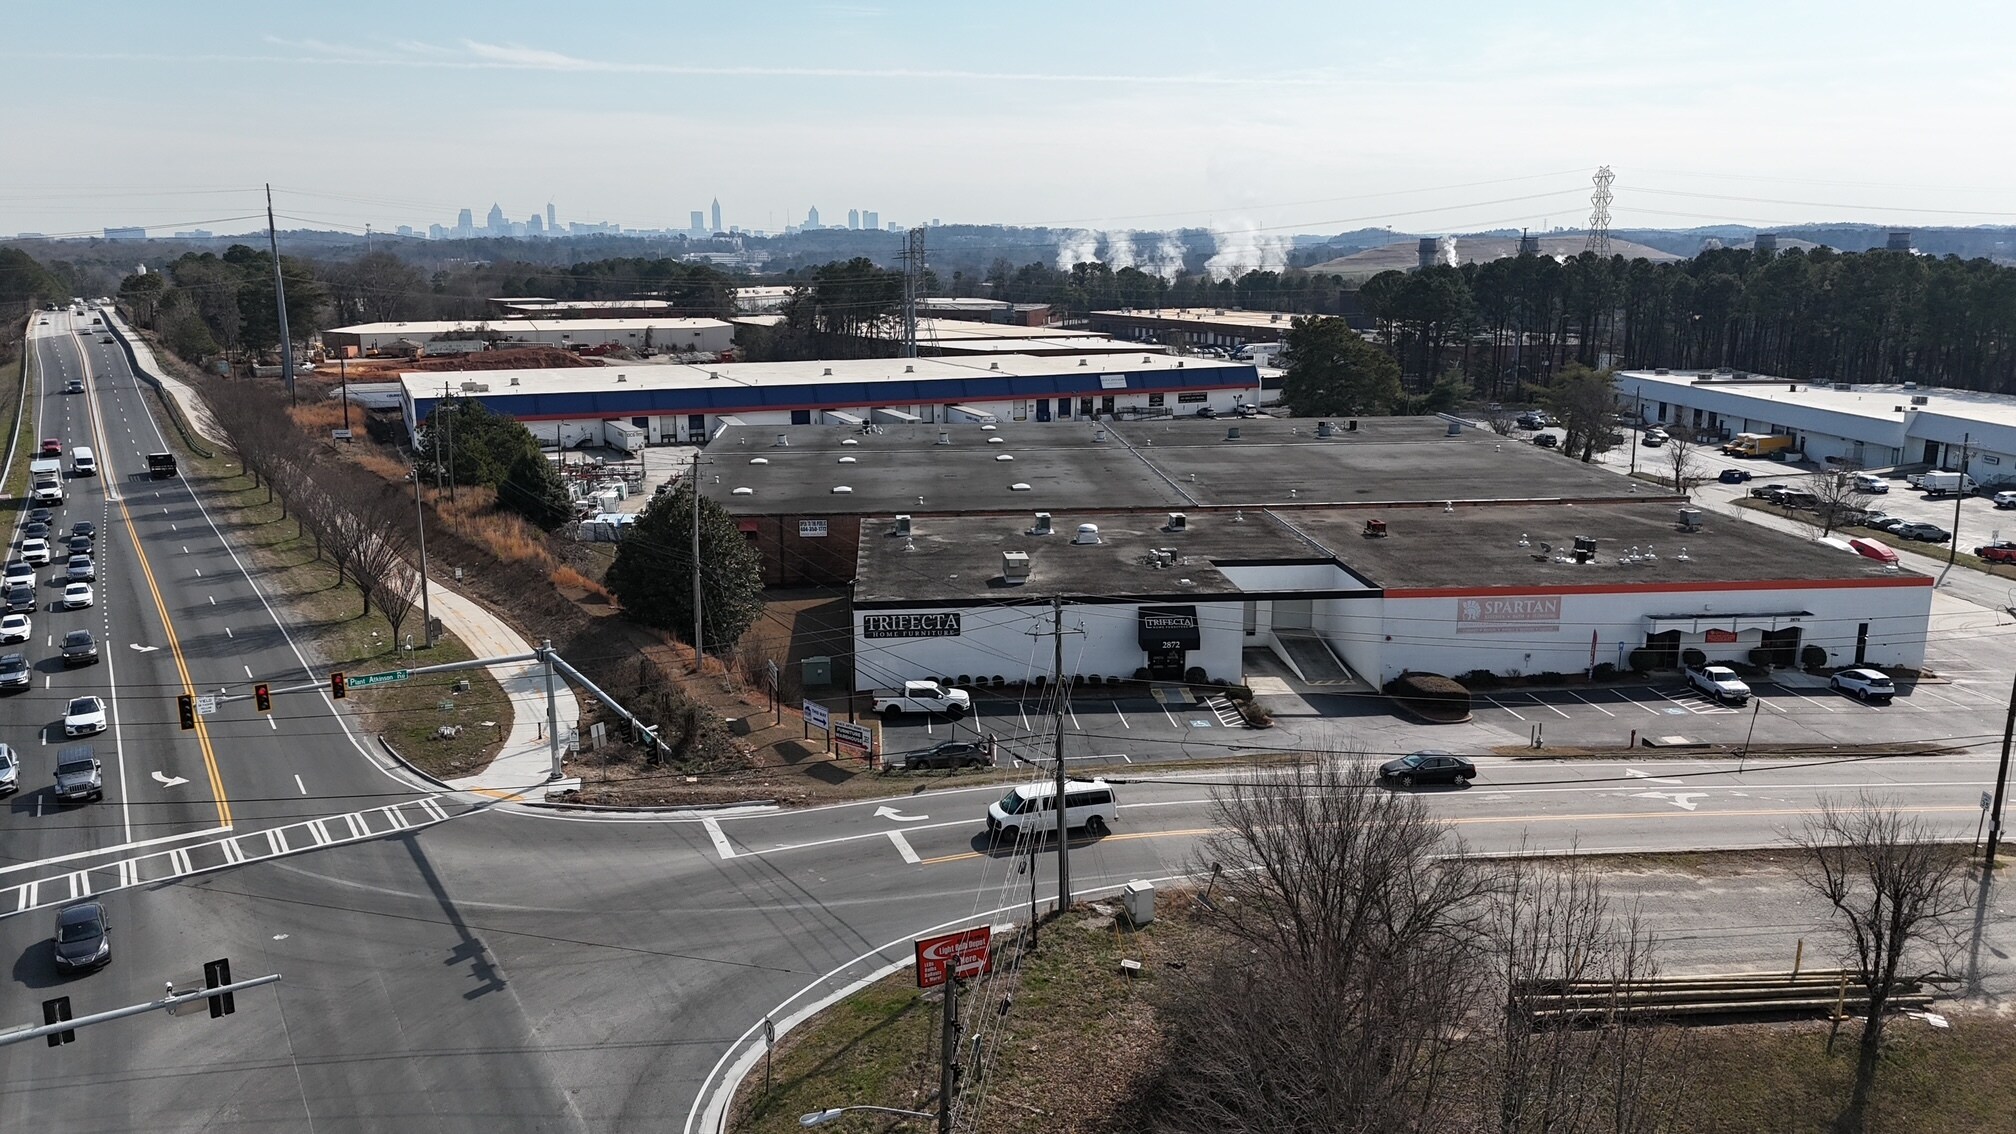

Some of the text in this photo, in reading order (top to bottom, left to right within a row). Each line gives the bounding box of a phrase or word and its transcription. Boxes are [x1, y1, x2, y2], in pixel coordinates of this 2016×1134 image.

[1485, 600, 1557, 614] SPARTAN
[865, 614, 959, 631] TRIFECTA
[1147, 618, 1191, 626] TRIFECTA
[350, 678, 366, 686] Plant
[369, 675, 394, 684] Atkinson
[836, 727, 861, 738] FURNITURE
[836, 732, 862, 743] WAREHOUSE
[939, 945, 954, 955] Light
[968, 938, 986, 947] Depot
